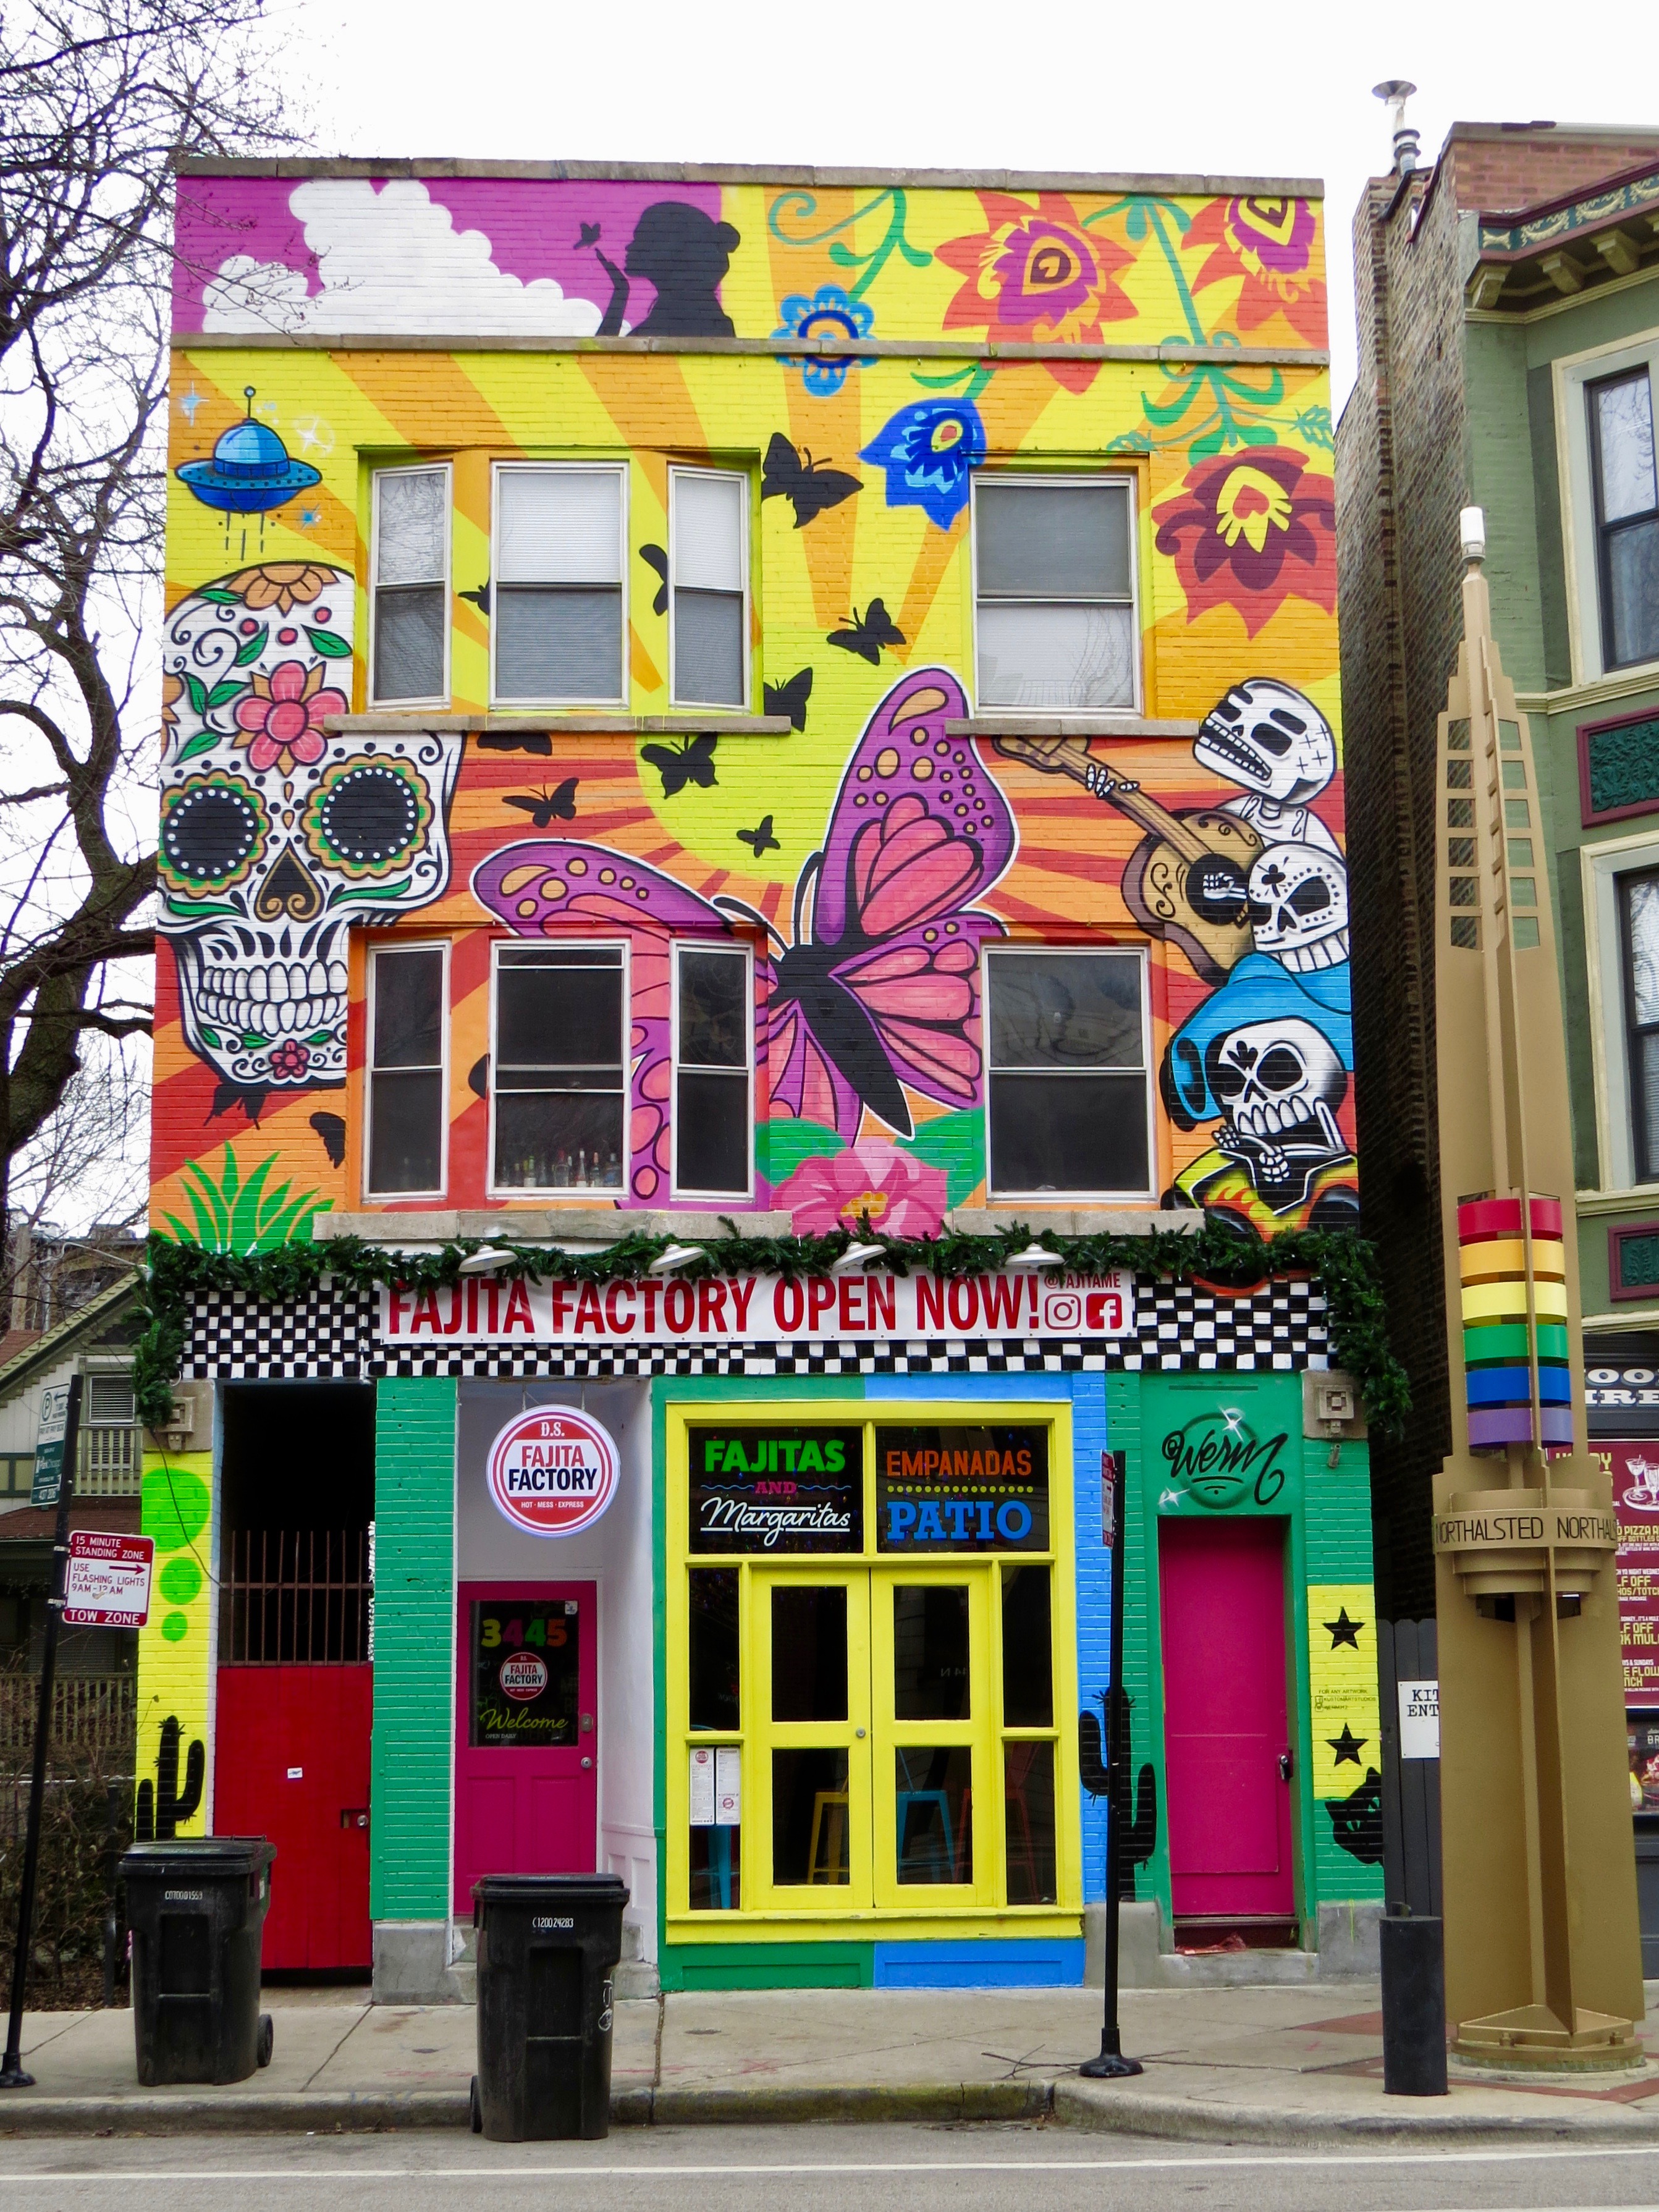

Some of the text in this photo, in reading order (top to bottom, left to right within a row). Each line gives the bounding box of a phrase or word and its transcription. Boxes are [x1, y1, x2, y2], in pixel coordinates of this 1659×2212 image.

[389, 1274, 1040, 1335] FAJITA FACTORY OPEN NOW!
[541, 1422, 565, 1437] D.S.
[521, 1445, 585, 1467] FAJITA
[704, 1440, 845, 1472] FAJITAS
[887, 1450, 1032, 1477] EMPANADAS
[509, 1468, 597, 1490] FACTORY
[754, 1482, 797, 1494] AND
[700, 1496, 851, 1547] Margaritas
[886, 1500, 1033, 1540] PATIO
[1436, 1516, 1543, 1543] NORTHALSTED
[1624, 1525, 1651, 1535] PIZZA
[76, 1535, 122, 1548] 15 MINUTE
[75, 1546, 145, 1560] STANDING ZONE
[74, 1563, 90, 1572] USE
[72, 1573, 145, 1587] FLASHING LIGHTS
[1631, 1576, 1651, 1587] OFF
[70, 1610, 140, 1625] TOW ZONE
[481, 1619, 567, 1648] 3445
[1633, 1622, 1653, 1633] OFF
[1633, 1634, 1659, 1645] MUL
[510, 1665, 538, 1674] FAJITA
[505, 1674, 542, 1684] FACTORY
[479, 1707, 568, 1730] Welcome
